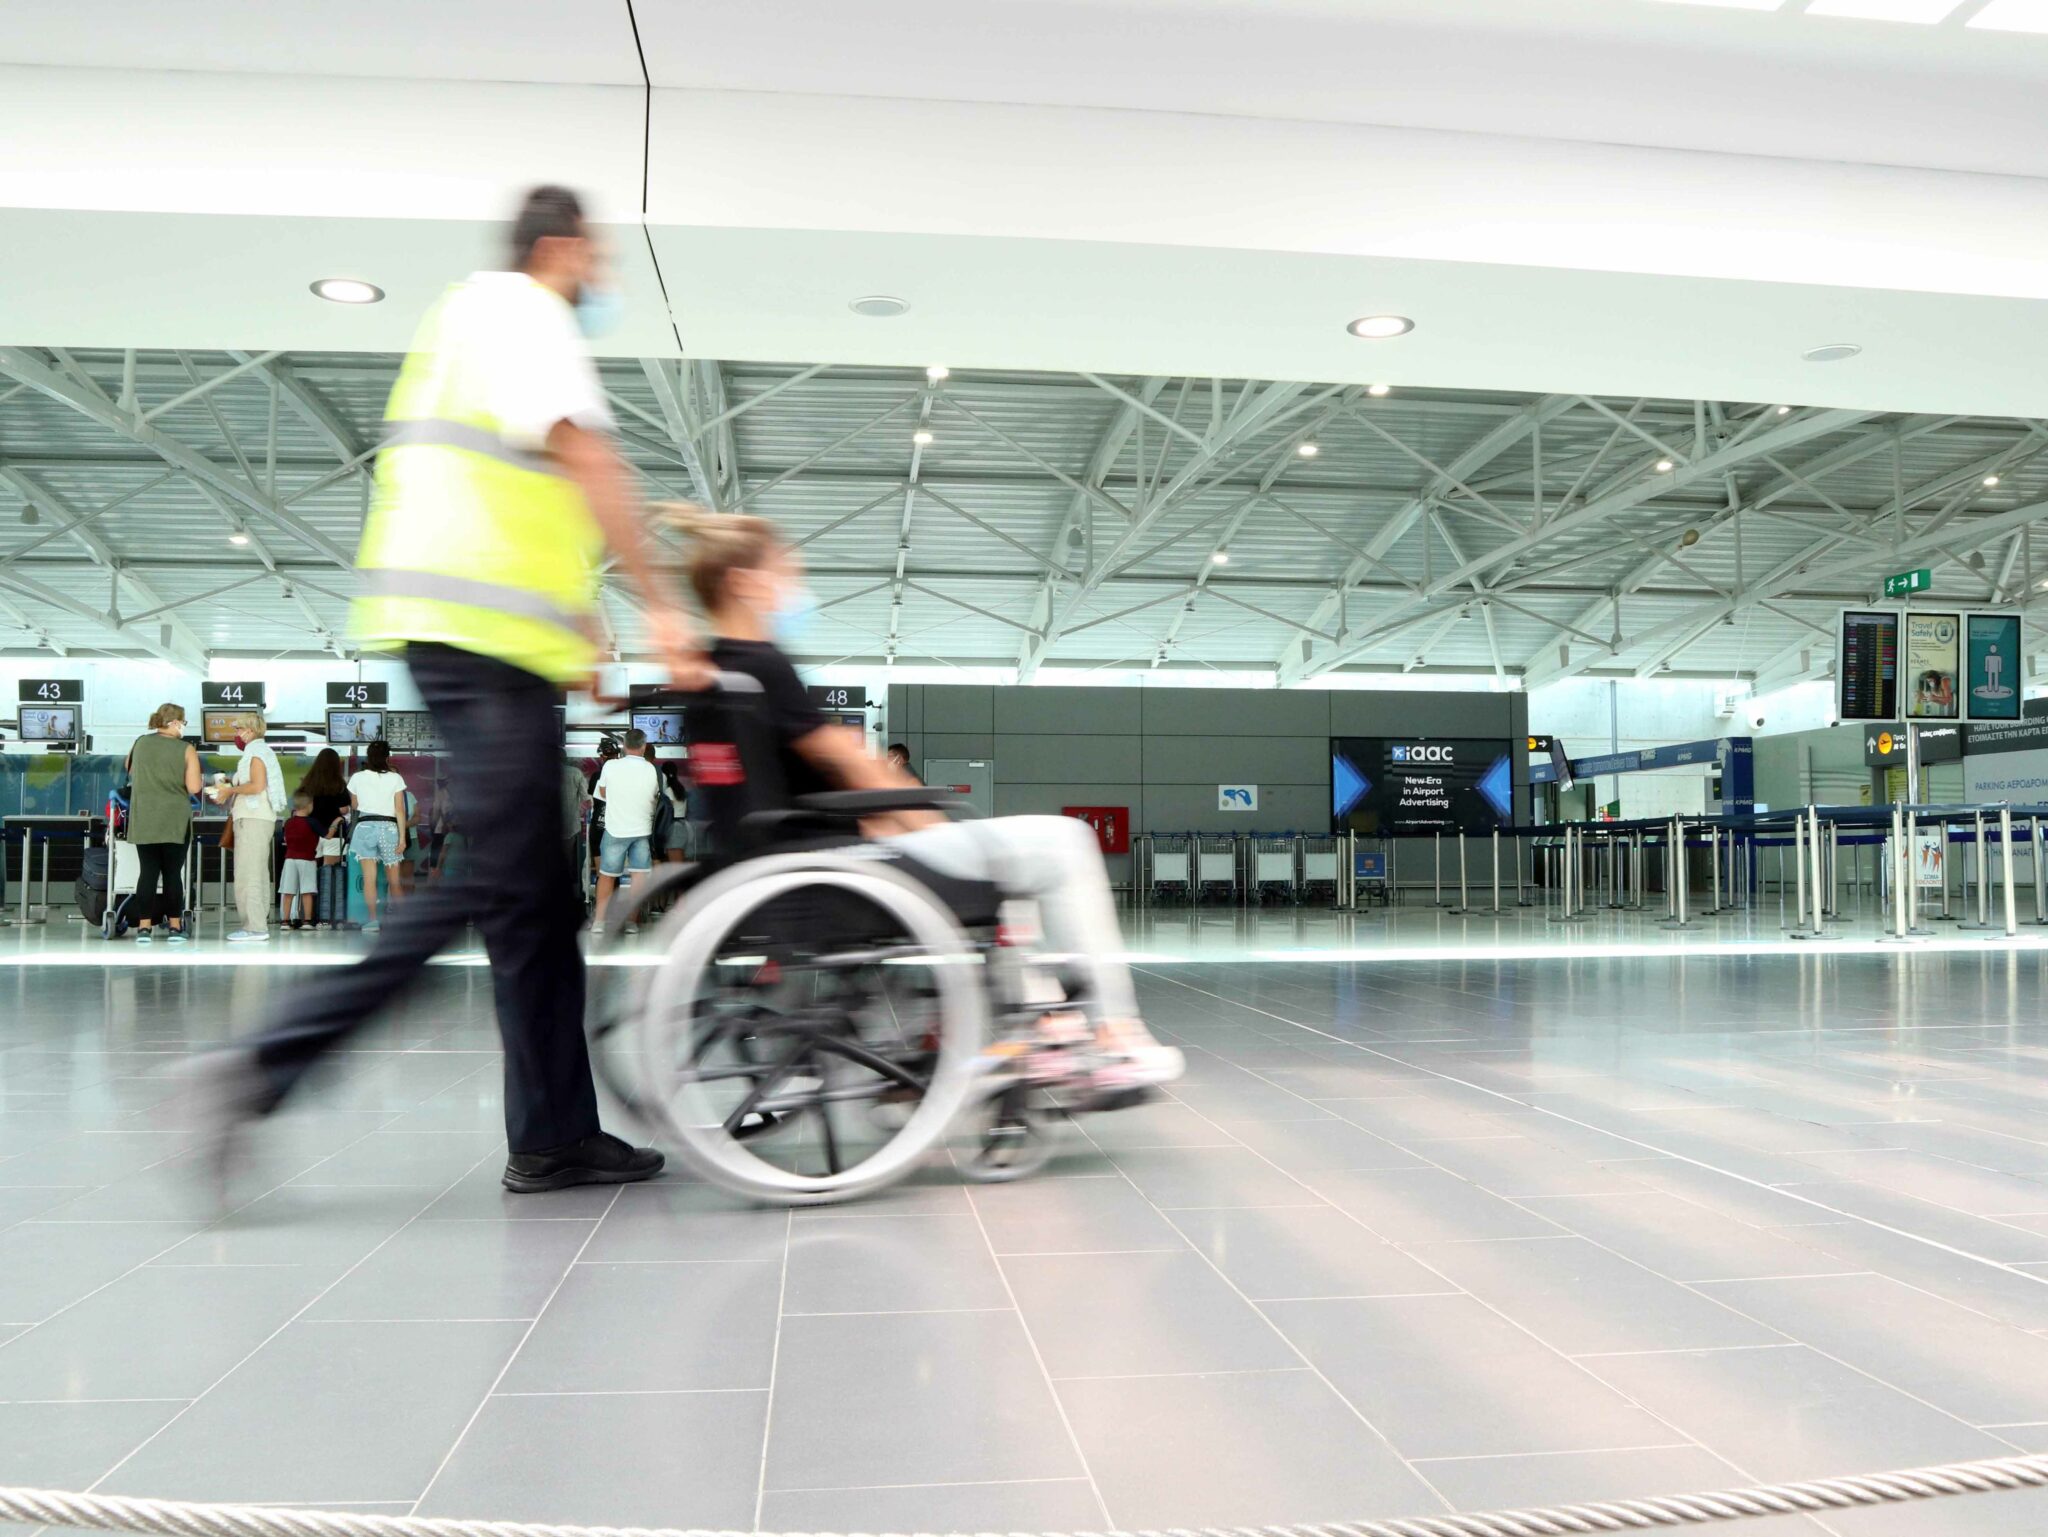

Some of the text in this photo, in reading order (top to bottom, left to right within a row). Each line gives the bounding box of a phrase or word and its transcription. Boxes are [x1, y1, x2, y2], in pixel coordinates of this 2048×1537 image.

[37, 683, 61, 699] 43
[220, 685, 244, 701] 44
[344, 685, 368, 701] 45
[825, 690, 848, 706] 48
[1405, 746, 1454, 761] iaac
[1404, 776, 1442, 785] New Era
[1975, 781, 2006, 791] PARKING
[1403, 787, 1444, 797] in Airport
[1399, 798, 1449, 809] Advertising
